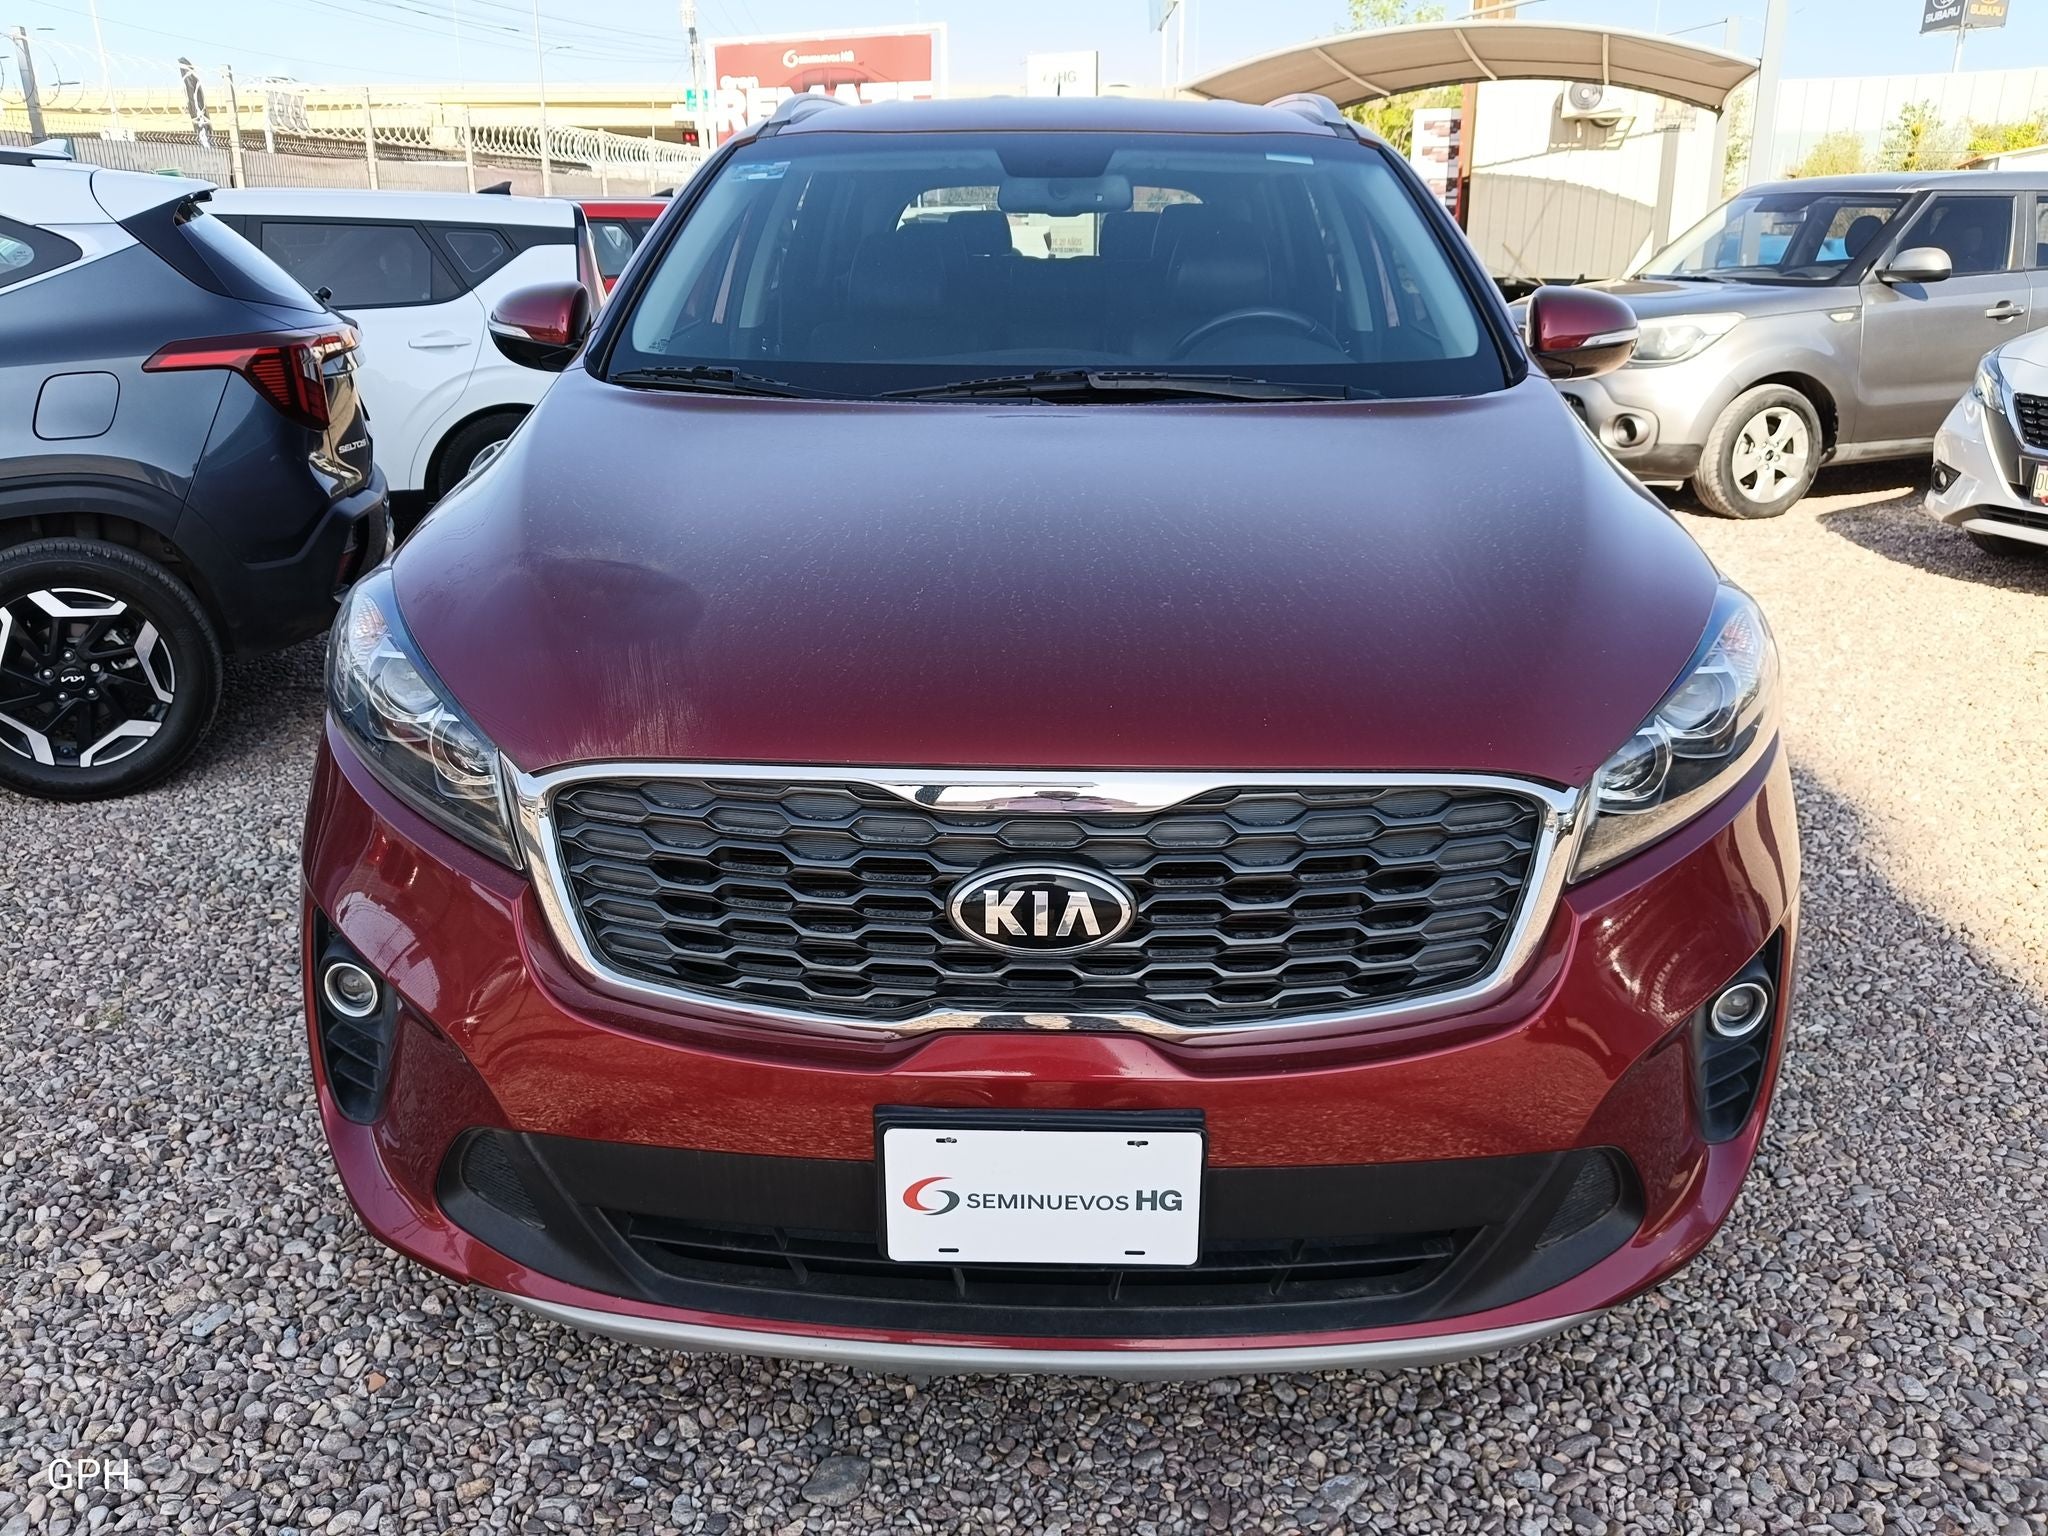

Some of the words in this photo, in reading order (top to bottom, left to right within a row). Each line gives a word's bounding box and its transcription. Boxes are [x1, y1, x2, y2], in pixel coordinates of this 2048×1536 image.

[1925, 6, 1960, 23] SUBARU
[1970, 4, 2004, 16] SUBARU
[339, 438, 367, 454] SELTOS
[983, 889, 1102, 937] KIA
[966, 1193, 1130, 1212] SEMINUEVOS
[1135, 1189, 1183, 1212] HG
